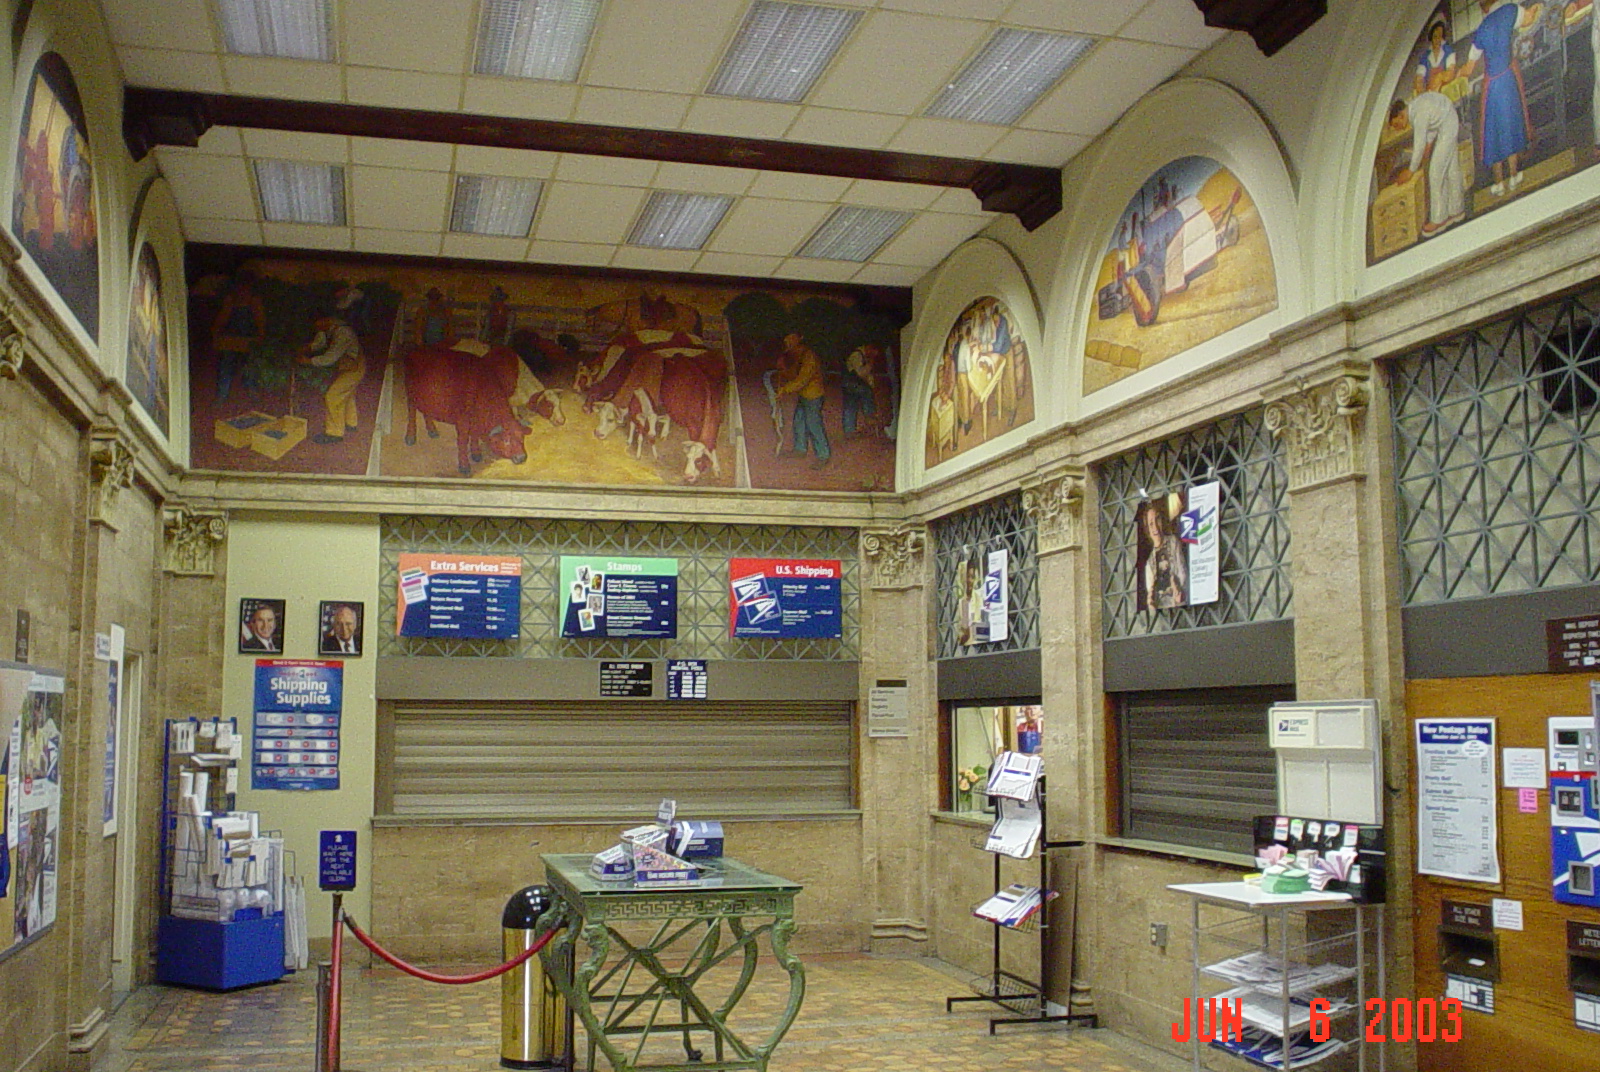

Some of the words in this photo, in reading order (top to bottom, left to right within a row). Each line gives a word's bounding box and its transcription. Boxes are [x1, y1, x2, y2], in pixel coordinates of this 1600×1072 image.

[430, 560, 457, 571] Extra
[459, 561, 499, 572] Services
[607, 561, 643, 572] Stamps
[776, 565, 793, 574] U.S.
[795, 565, 834, 577] Shipping
[270, 677, 328, 694] Shipping
[276, 691, 331, 707] Supplies
